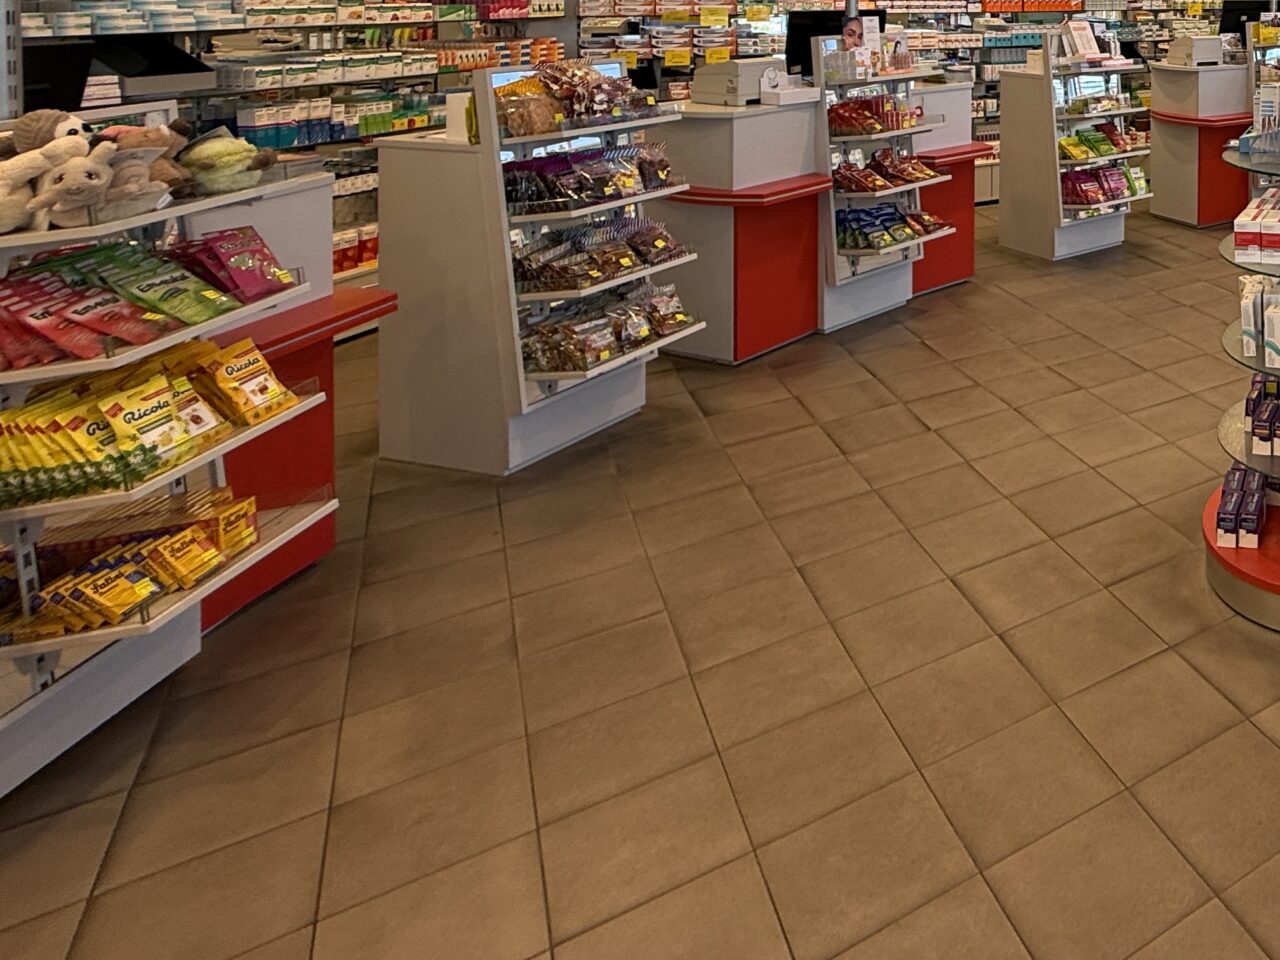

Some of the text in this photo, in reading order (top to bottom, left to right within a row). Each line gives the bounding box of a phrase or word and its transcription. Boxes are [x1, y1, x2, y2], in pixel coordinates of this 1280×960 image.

[225, 356, 262, 376] Ricola
[123, 398, 171, 425] Ricola
[86, 420, 111, 437] Ric
